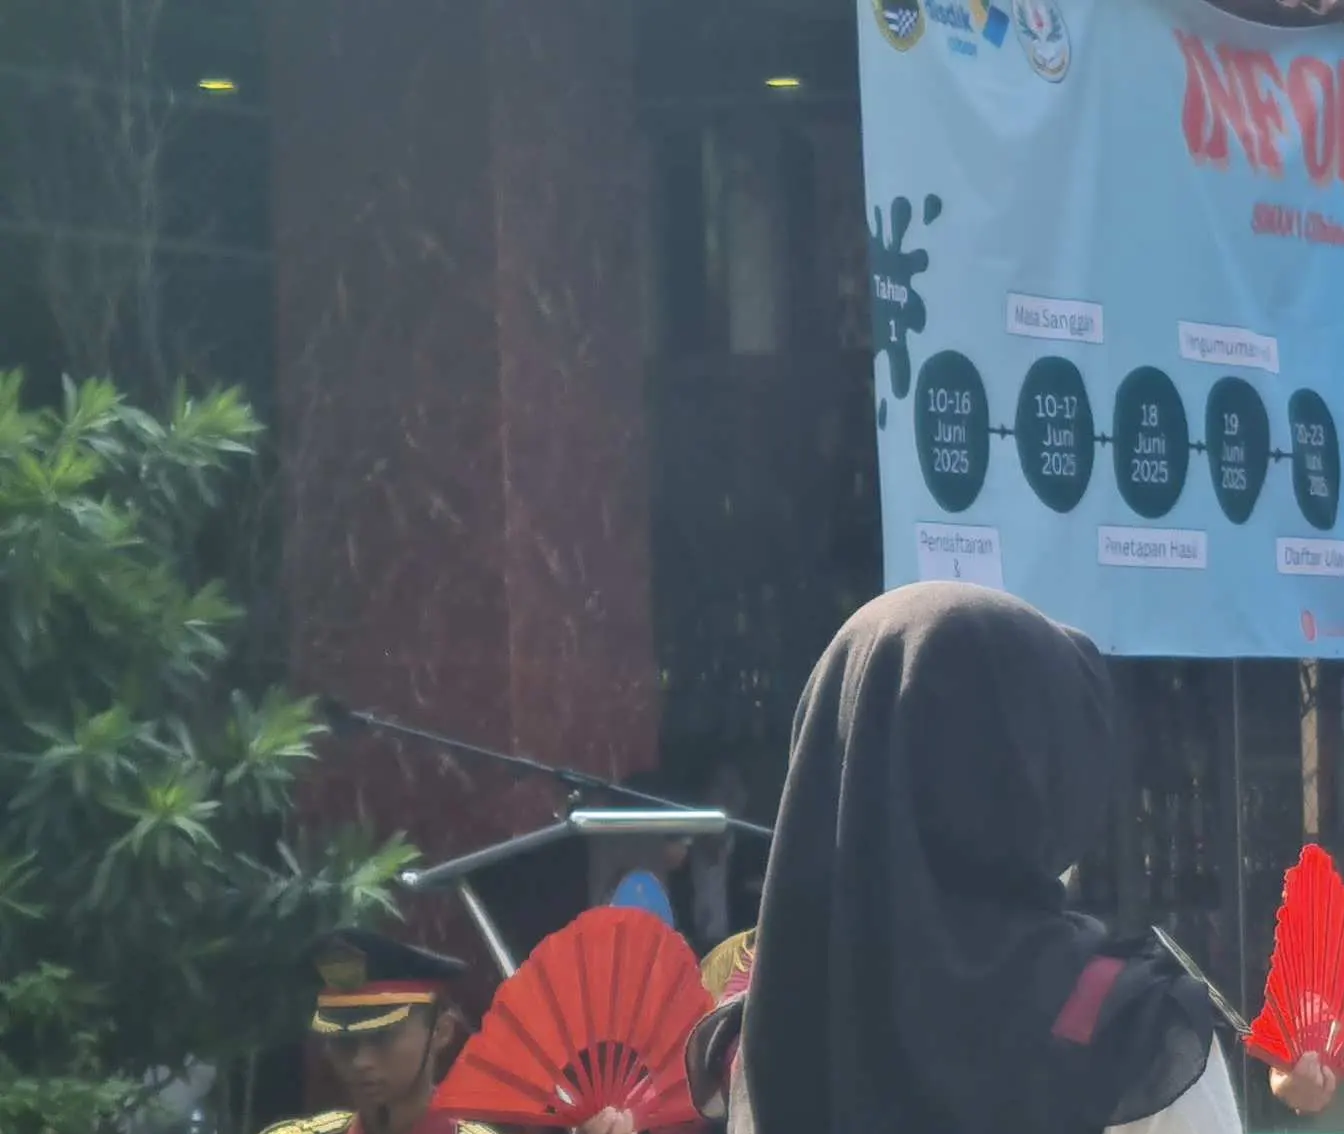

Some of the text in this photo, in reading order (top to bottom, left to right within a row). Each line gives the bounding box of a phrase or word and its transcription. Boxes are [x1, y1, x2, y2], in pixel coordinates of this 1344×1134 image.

[874, 274, 908, 308] Tahap
[888, 320, 898, 343] 1
[928, 387, 972, 415] 10-16
[1034, 394, 1078, 419] 10-17
[1140, 403, 1159, 427] 18
[1222, 412, 1240, 436] 19
[934, 419, 967, 444] Juni
[1042, 422, 1075, 447] Juni
[1133, 432, 1166, 455] Juni
[934, 448, 970, 474] 2025
[1040, 451, 1077, 476] 2025
[1131, 459, 1169, 483] 2025
[1221, 466, 1248, 491] 2025
[919, 529, 994, 554] Pendaftaran
